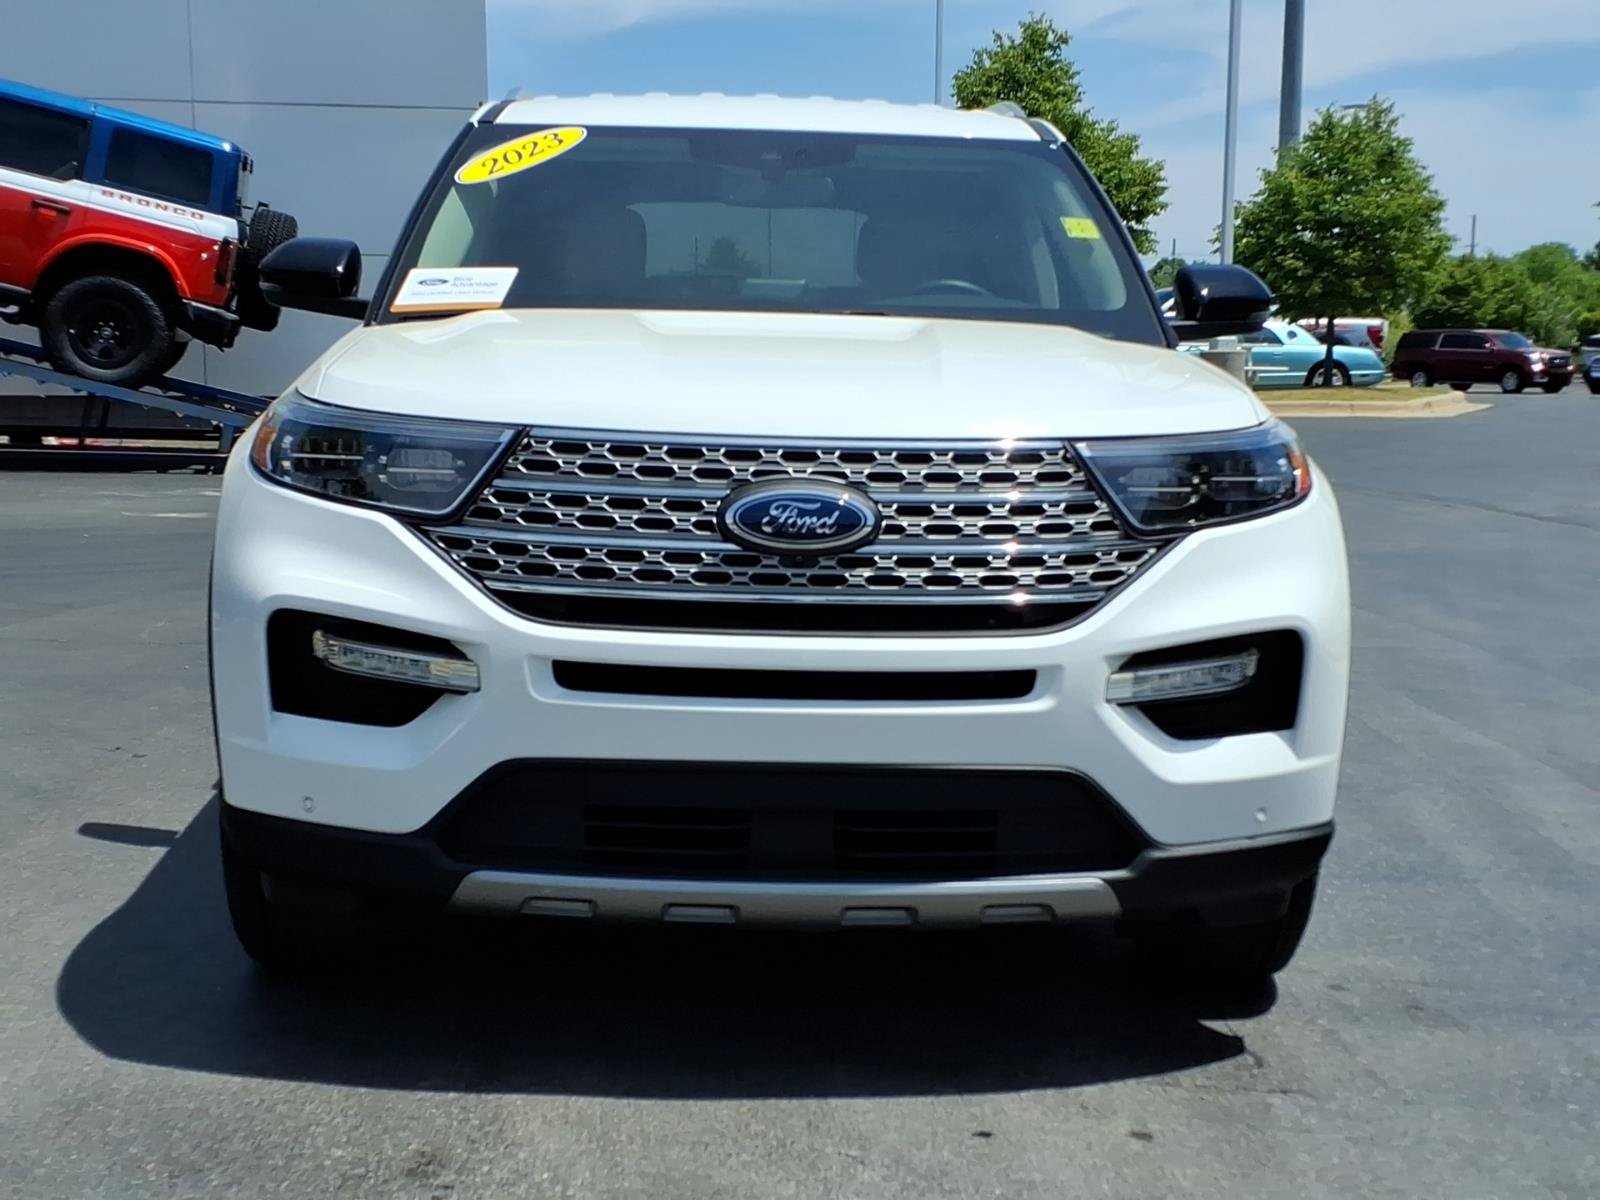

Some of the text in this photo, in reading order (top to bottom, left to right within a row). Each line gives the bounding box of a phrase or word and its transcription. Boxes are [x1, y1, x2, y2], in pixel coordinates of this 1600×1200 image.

[481, 133, 564, 175] 2023
[101, 190, 204, 220] BRONCO
[761, 500, 840, 534] Ford
